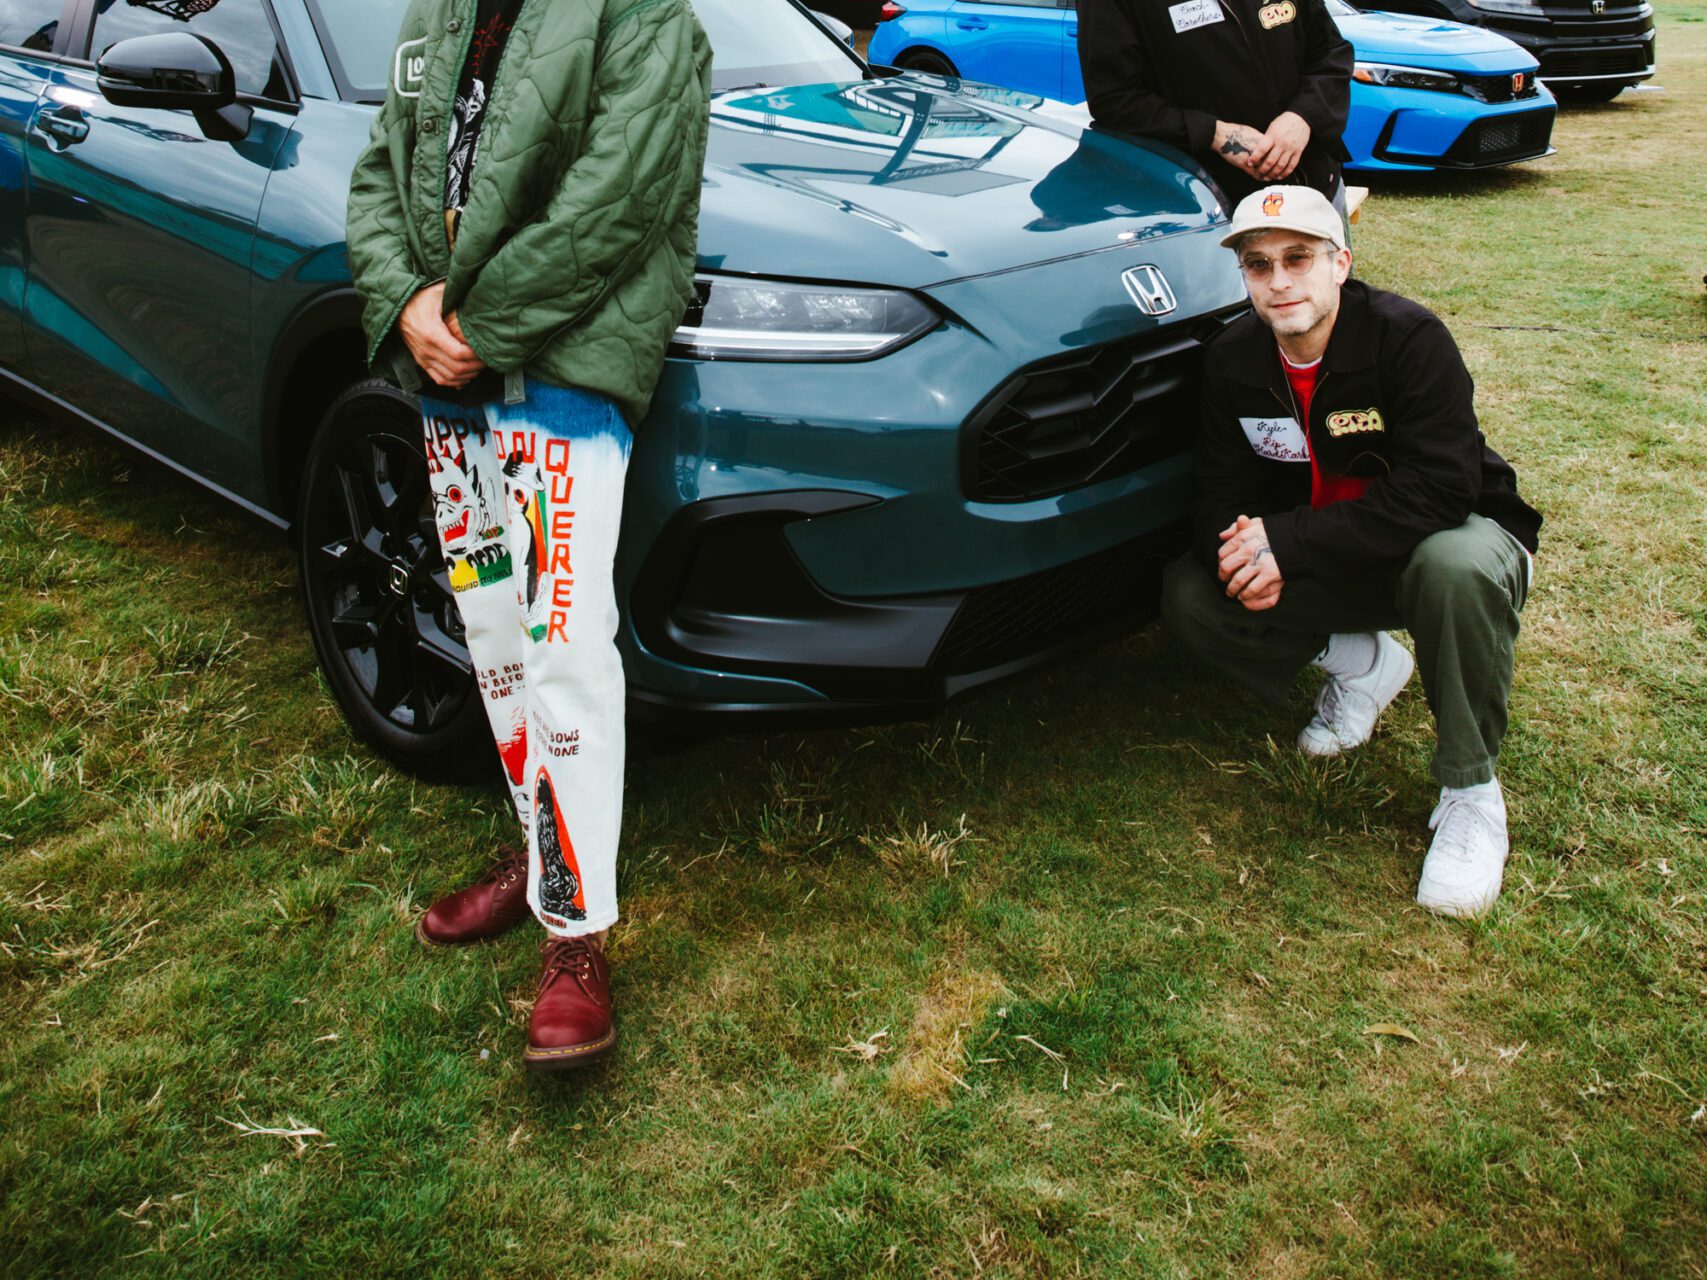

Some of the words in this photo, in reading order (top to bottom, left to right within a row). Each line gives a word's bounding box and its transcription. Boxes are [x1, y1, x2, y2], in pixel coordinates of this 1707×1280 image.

[1257, 421, 1287, 436] Kyle
[493, 672, 524, 688] BEFO
[549, 729, 580, 744] BOWS
